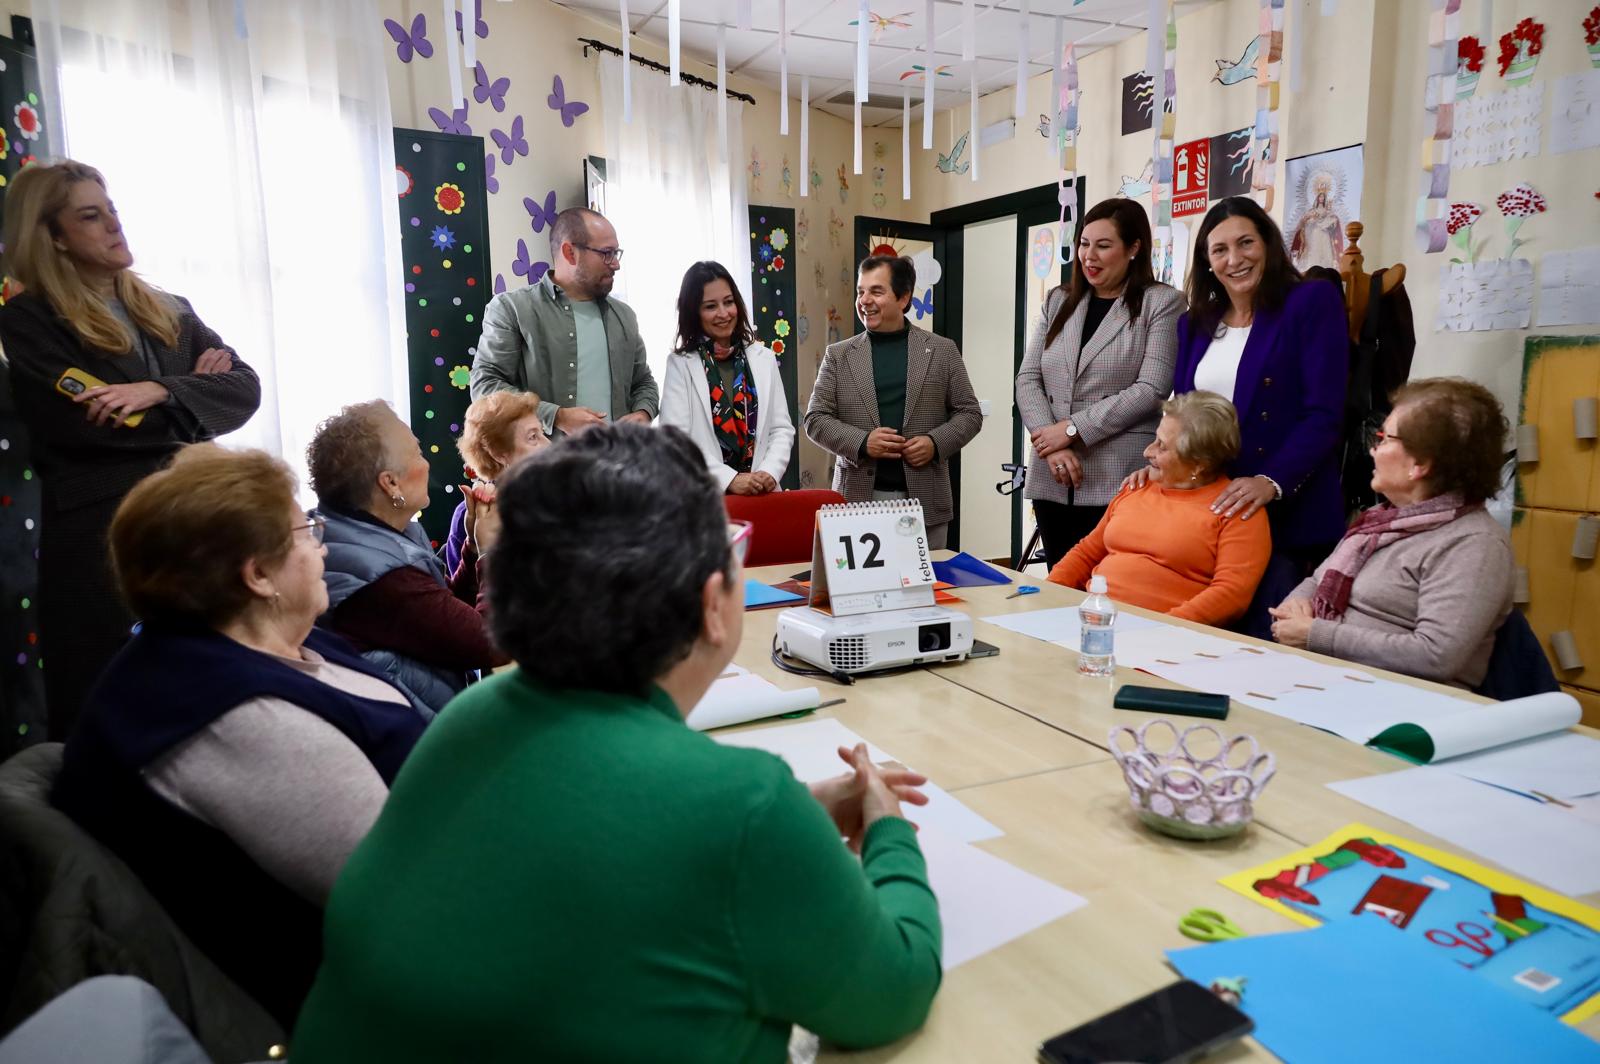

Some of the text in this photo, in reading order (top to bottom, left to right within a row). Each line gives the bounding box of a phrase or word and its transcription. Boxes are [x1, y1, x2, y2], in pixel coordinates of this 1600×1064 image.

[1173, 198, 1206, 213] EXTINTOR
[839, 532, 884, 569] 12
[916, 536, 932, 582] febrero
